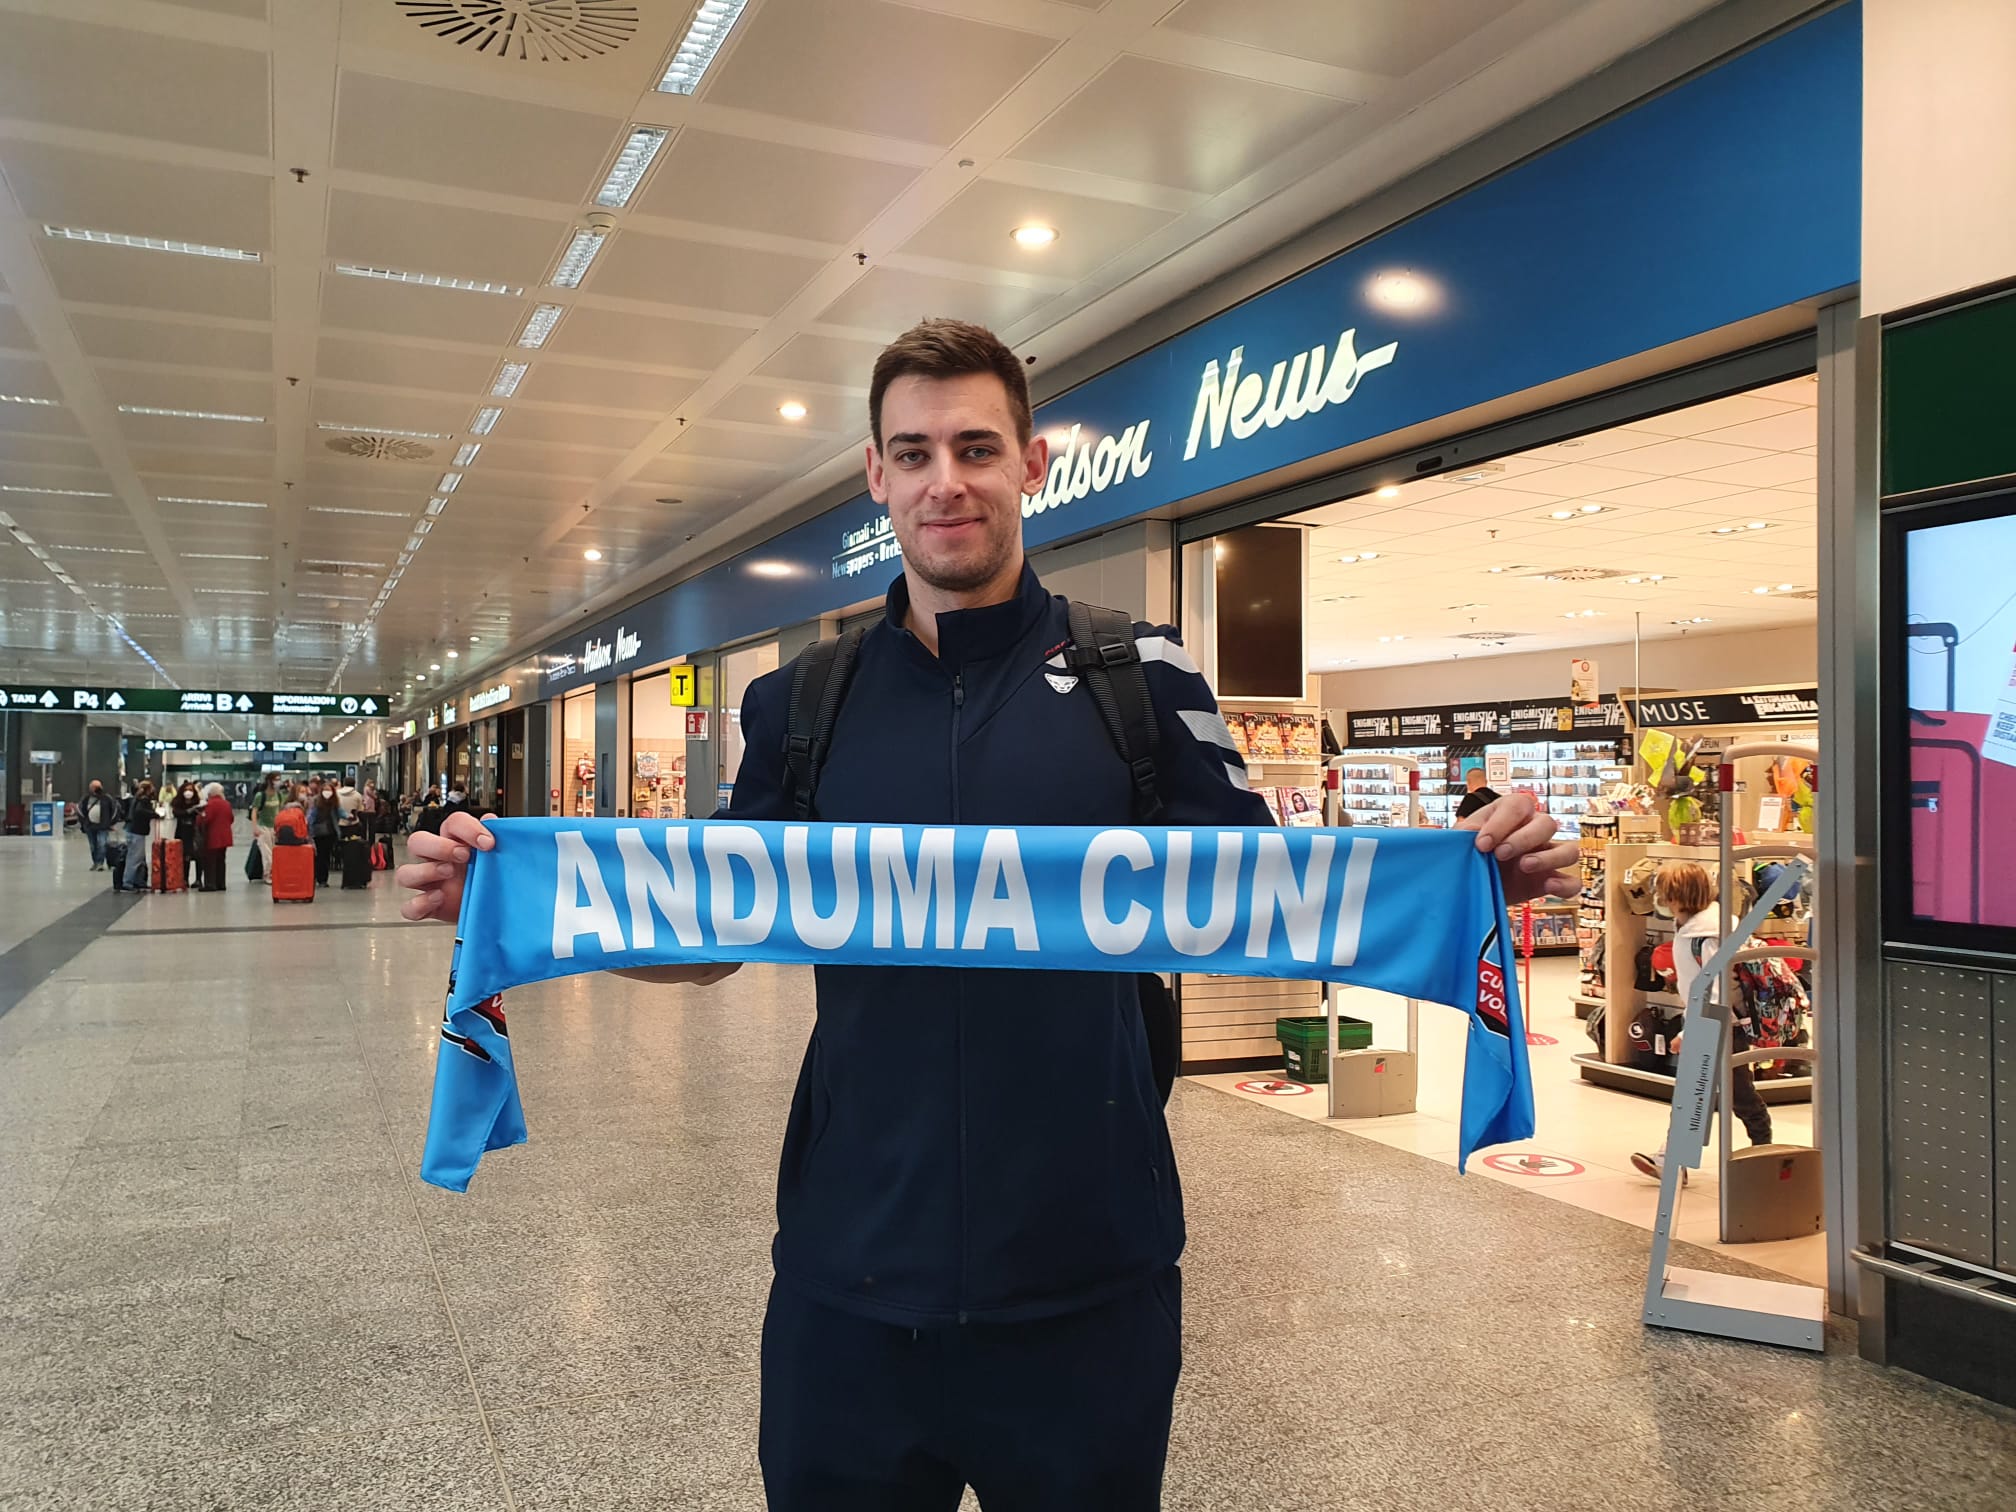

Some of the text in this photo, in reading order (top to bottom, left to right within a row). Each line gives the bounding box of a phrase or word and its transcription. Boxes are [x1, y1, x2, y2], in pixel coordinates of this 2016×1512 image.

[1183, 328, 1399, 461] News
[615, 626, 642, 664] News
[11, 693, 37, 704] TAXI
[73, 690, 100, 710] P4
[217, 693, 234, 712] B
[1640, 701, 1711, 722] MUSE
[552, 825, 1379, 967] ANDUMA CUNI
